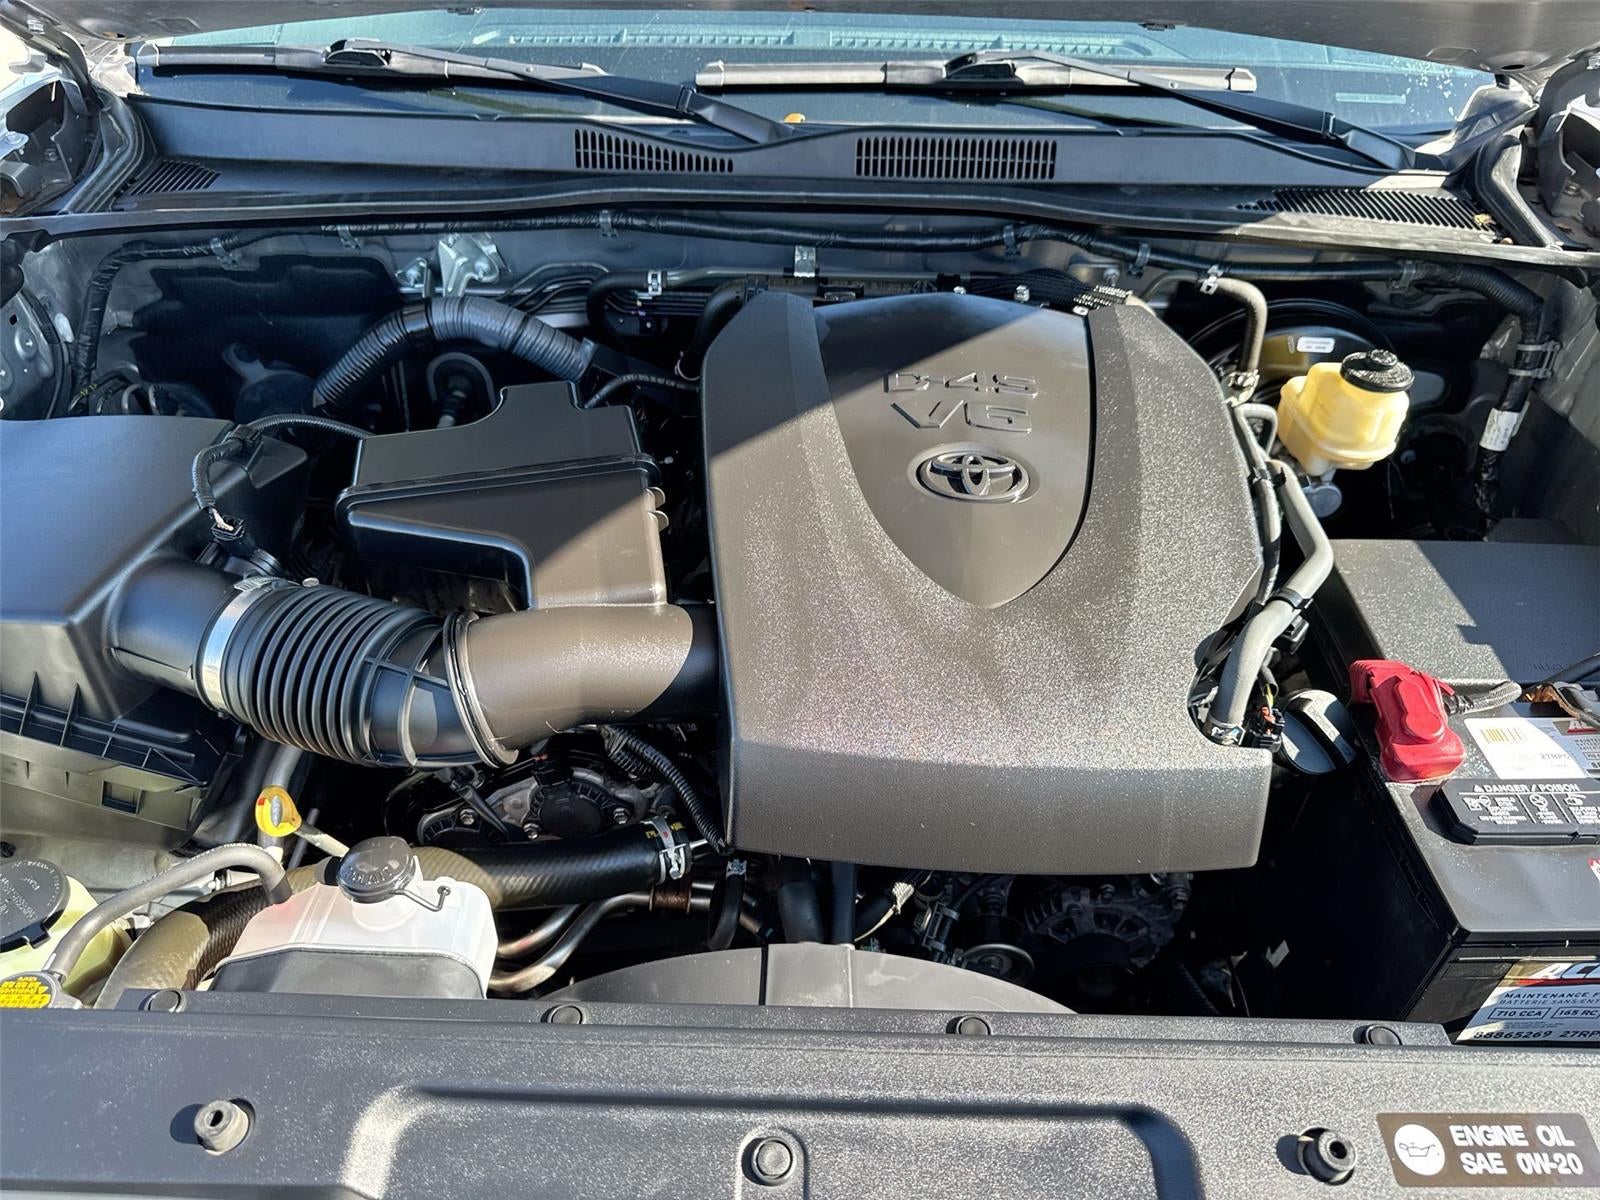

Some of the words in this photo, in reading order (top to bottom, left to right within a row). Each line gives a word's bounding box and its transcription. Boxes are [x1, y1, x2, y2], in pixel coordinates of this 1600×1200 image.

[890, 399, 1033, 433] V6
[1483, 784, 1529, 792] DANGER
[1537, 783, 1580, 792] POISON
[1559, 1030, 1600, 1038] 27RP
[1449, 1125, 1529, 1146] ENGINE
[1536, 1125, 1576, 1146] OIL
[1460, 1153, 1507, 1174] SAE
[1516, 1152, 1584, 1175] 0W-20
